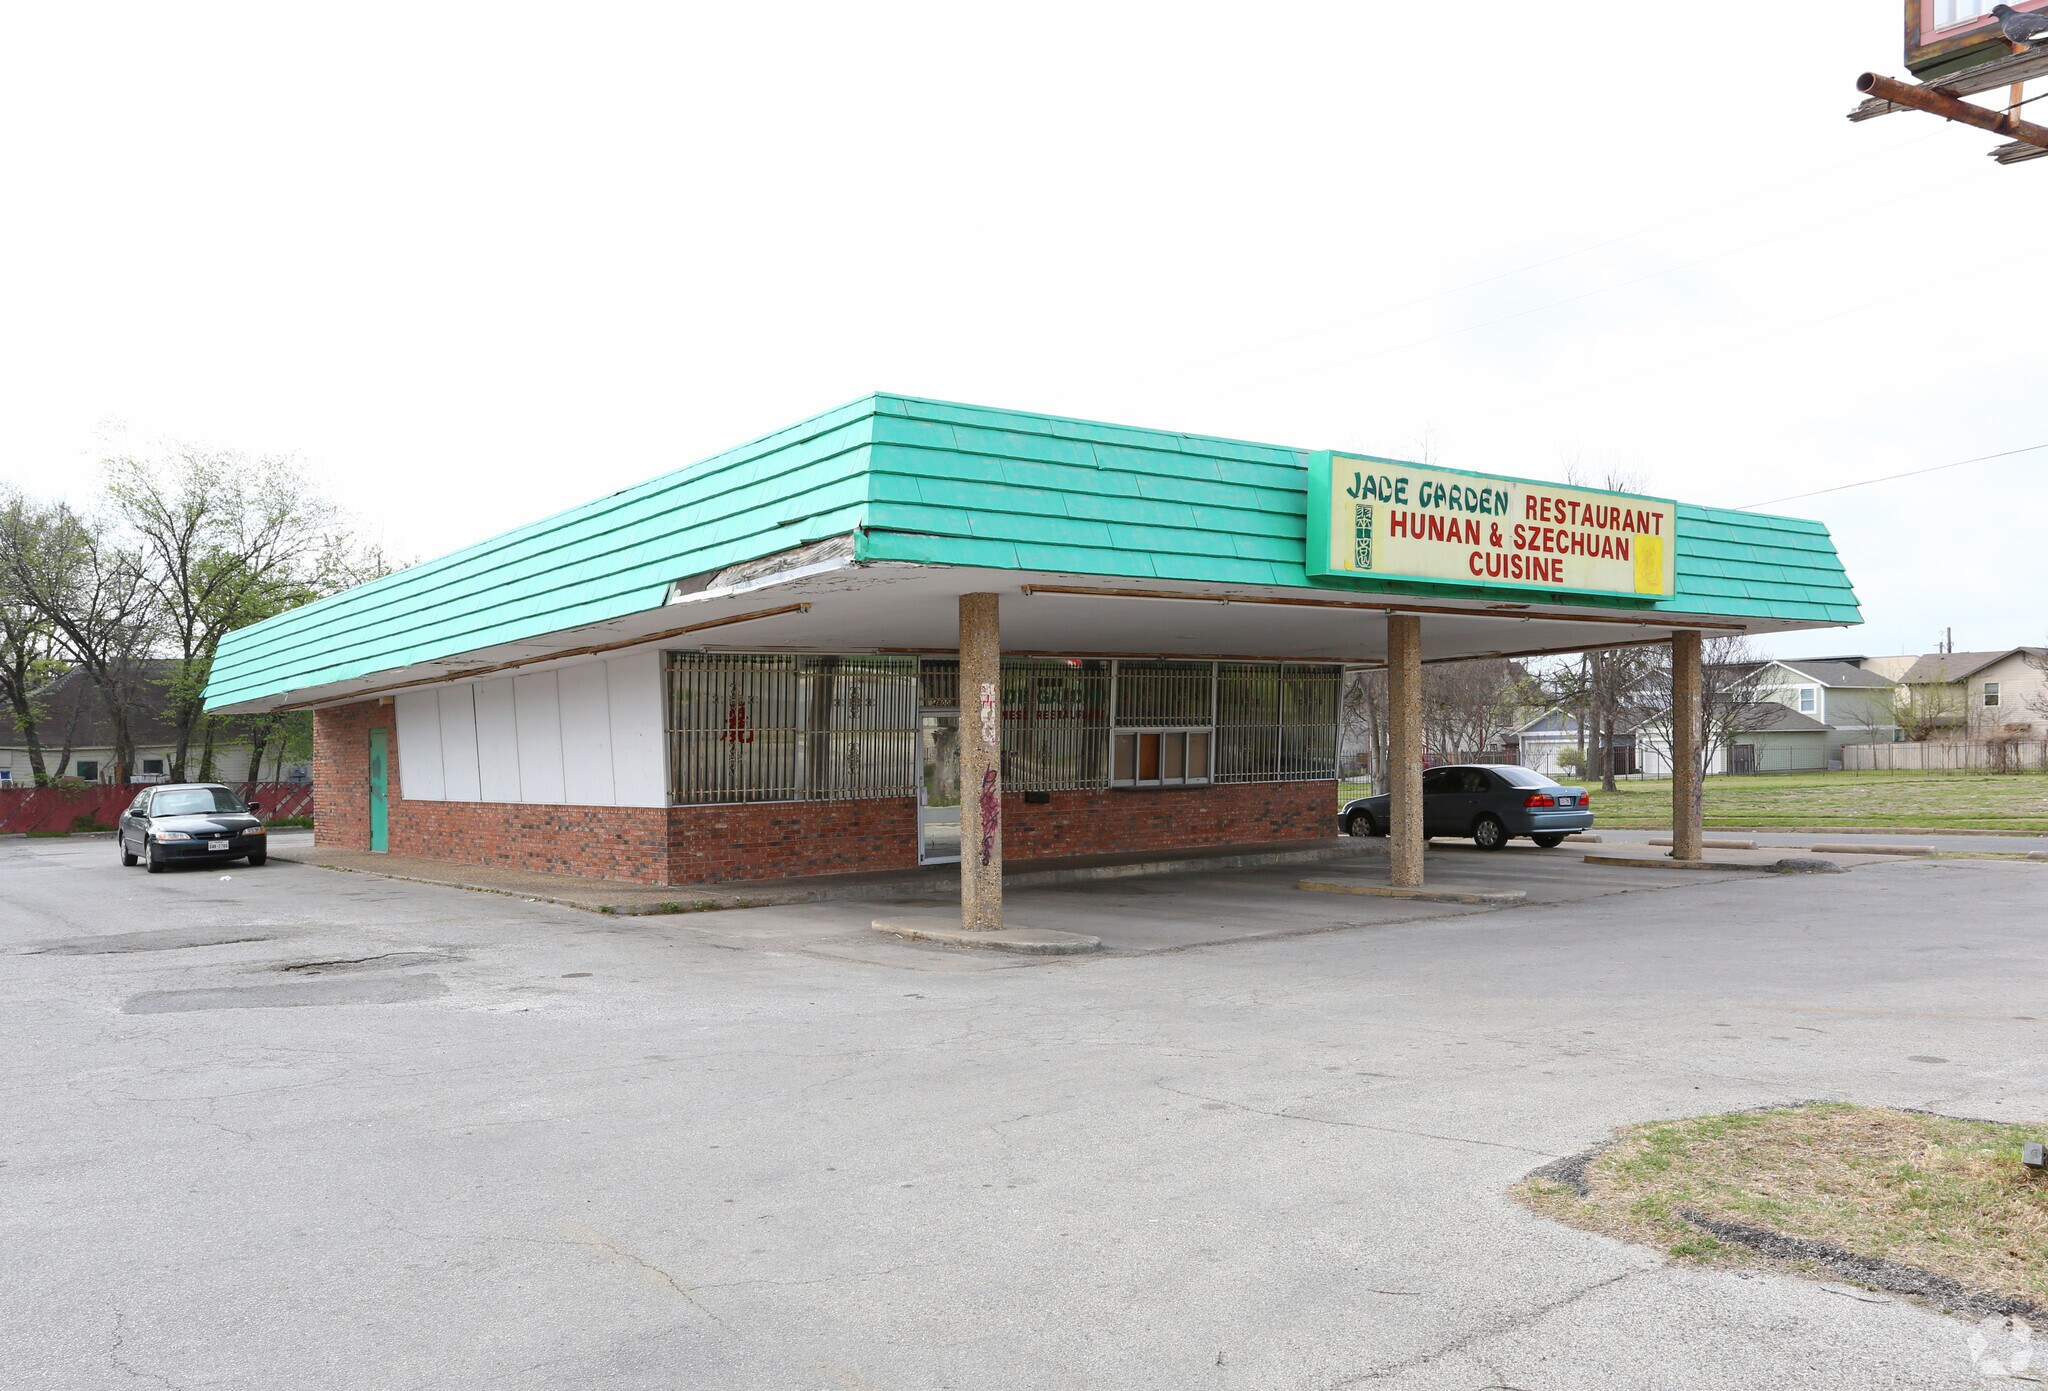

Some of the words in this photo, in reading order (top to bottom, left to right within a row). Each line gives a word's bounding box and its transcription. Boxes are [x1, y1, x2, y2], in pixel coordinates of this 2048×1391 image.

[1346, 472, 1409, 506] JADE
[1419, 481, 1509, 517] GARDEN
[1525, 494, 1664, 536] RESTAURANT
[1390, 509, 1481, 546] HUNAN
[1489, 521, 1503, 548] &
[1513, 523, 1630, 562] SZECHUAN
[1469, 551, 1564, 583] CUISINE
